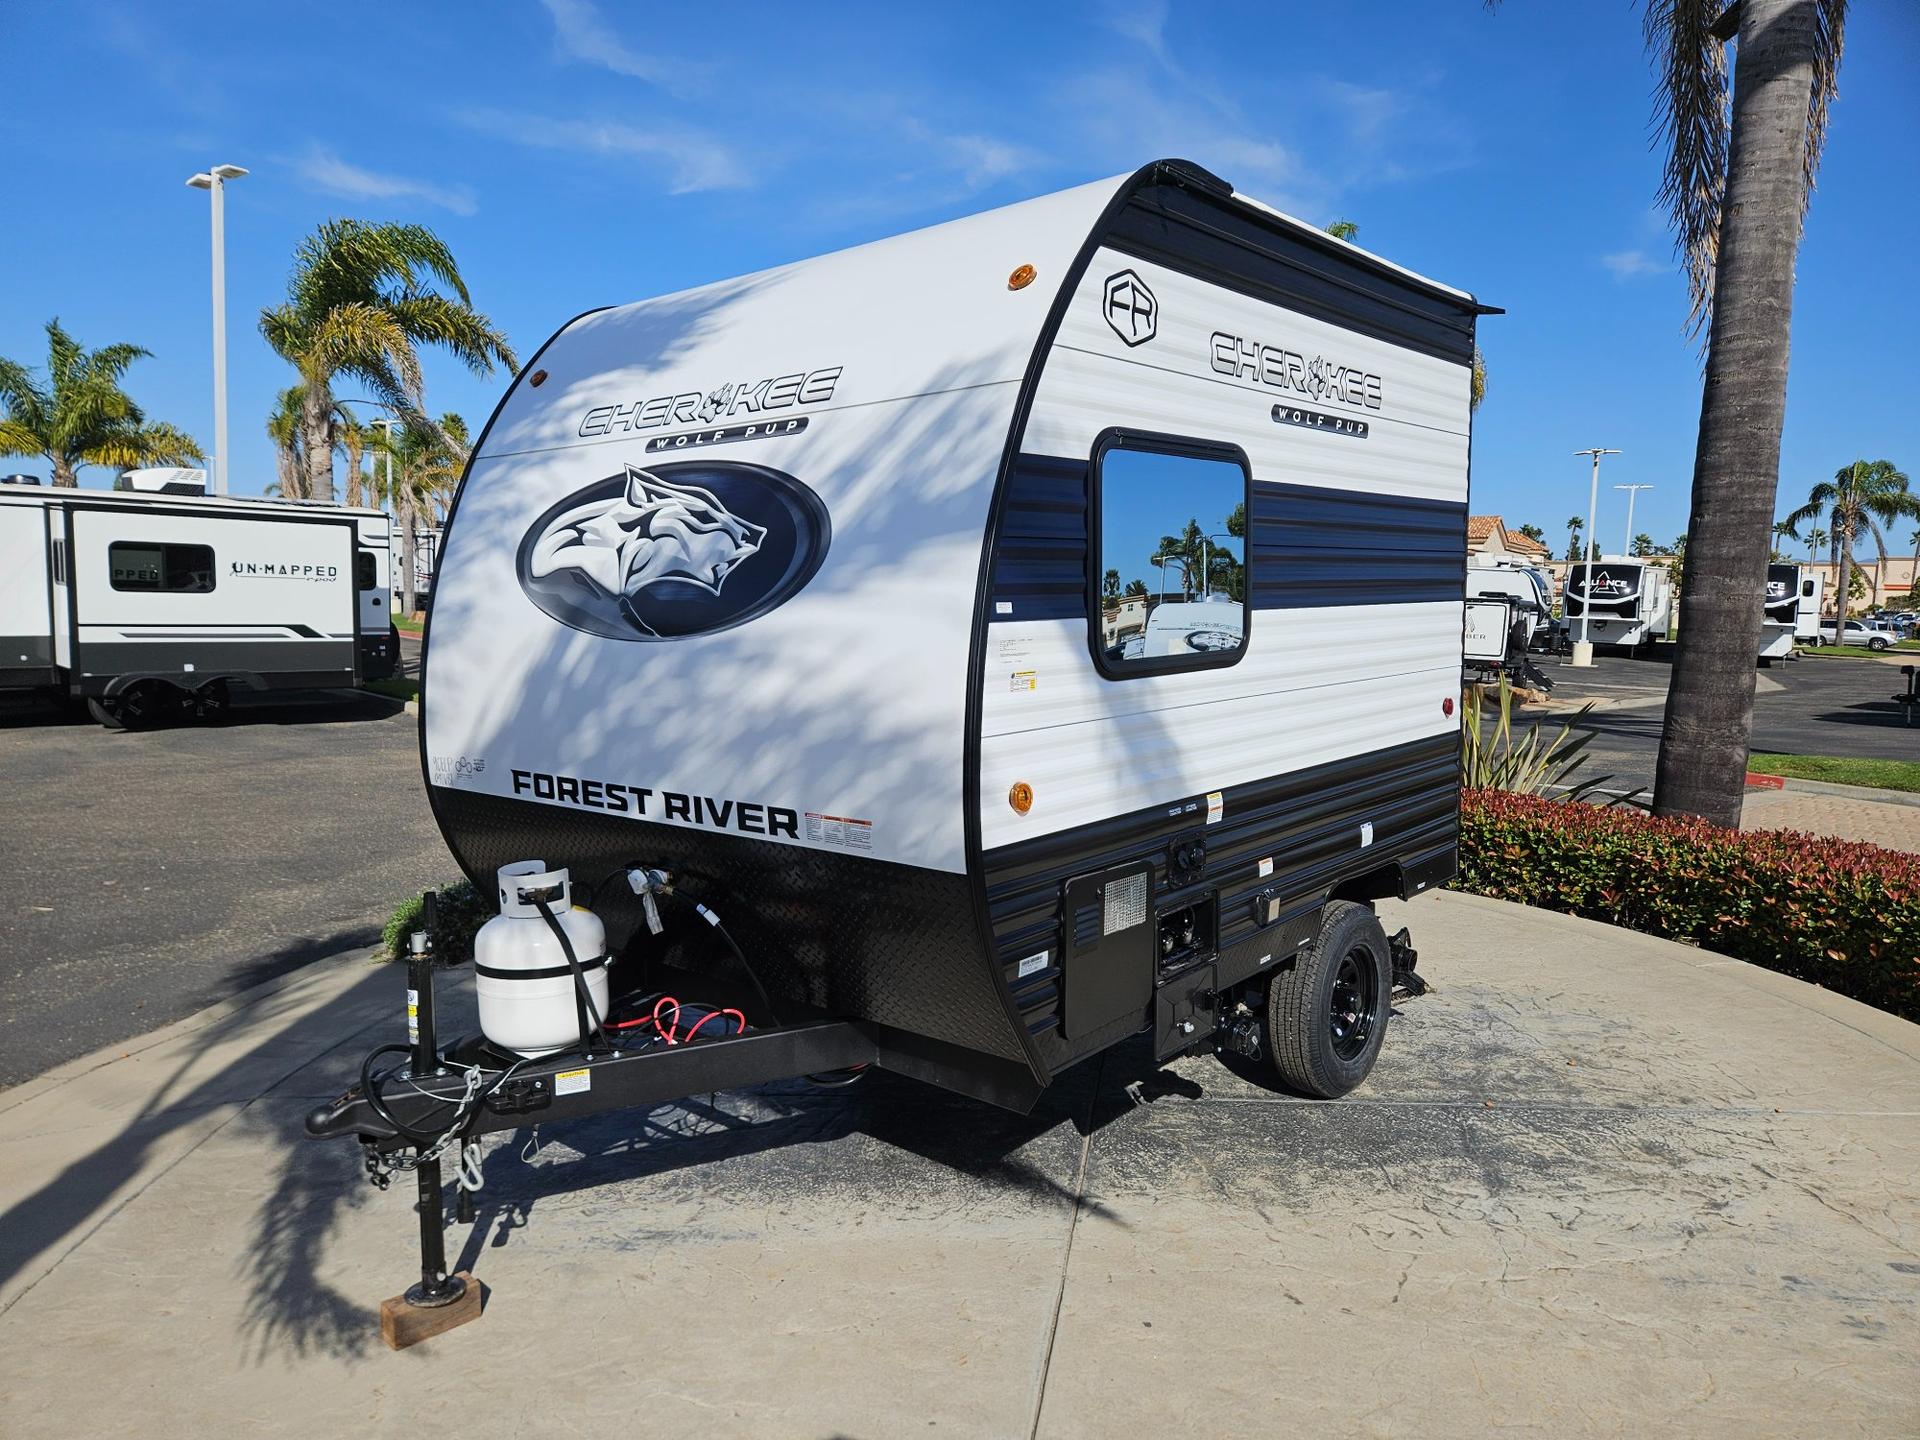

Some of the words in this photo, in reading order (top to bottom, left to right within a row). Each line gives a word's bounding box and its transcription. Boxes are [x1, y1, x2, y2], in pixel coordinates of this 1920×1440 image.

[1210, 331, 1382, 410] CHEROKEE
[579, 366, 843, 437] CHEROKEE
[1279, 407, 1324, 426] WOLF
[1336, 419, 1365, 434] PUP
[656, 430, 724, 449] WOLF
[744, 420, 799, 438] PUP
[1578, 579, 1628, 588] ALIANCE
[510, 769, 653, 815] FOREST
[662, 791, 800, 840] RIVER
